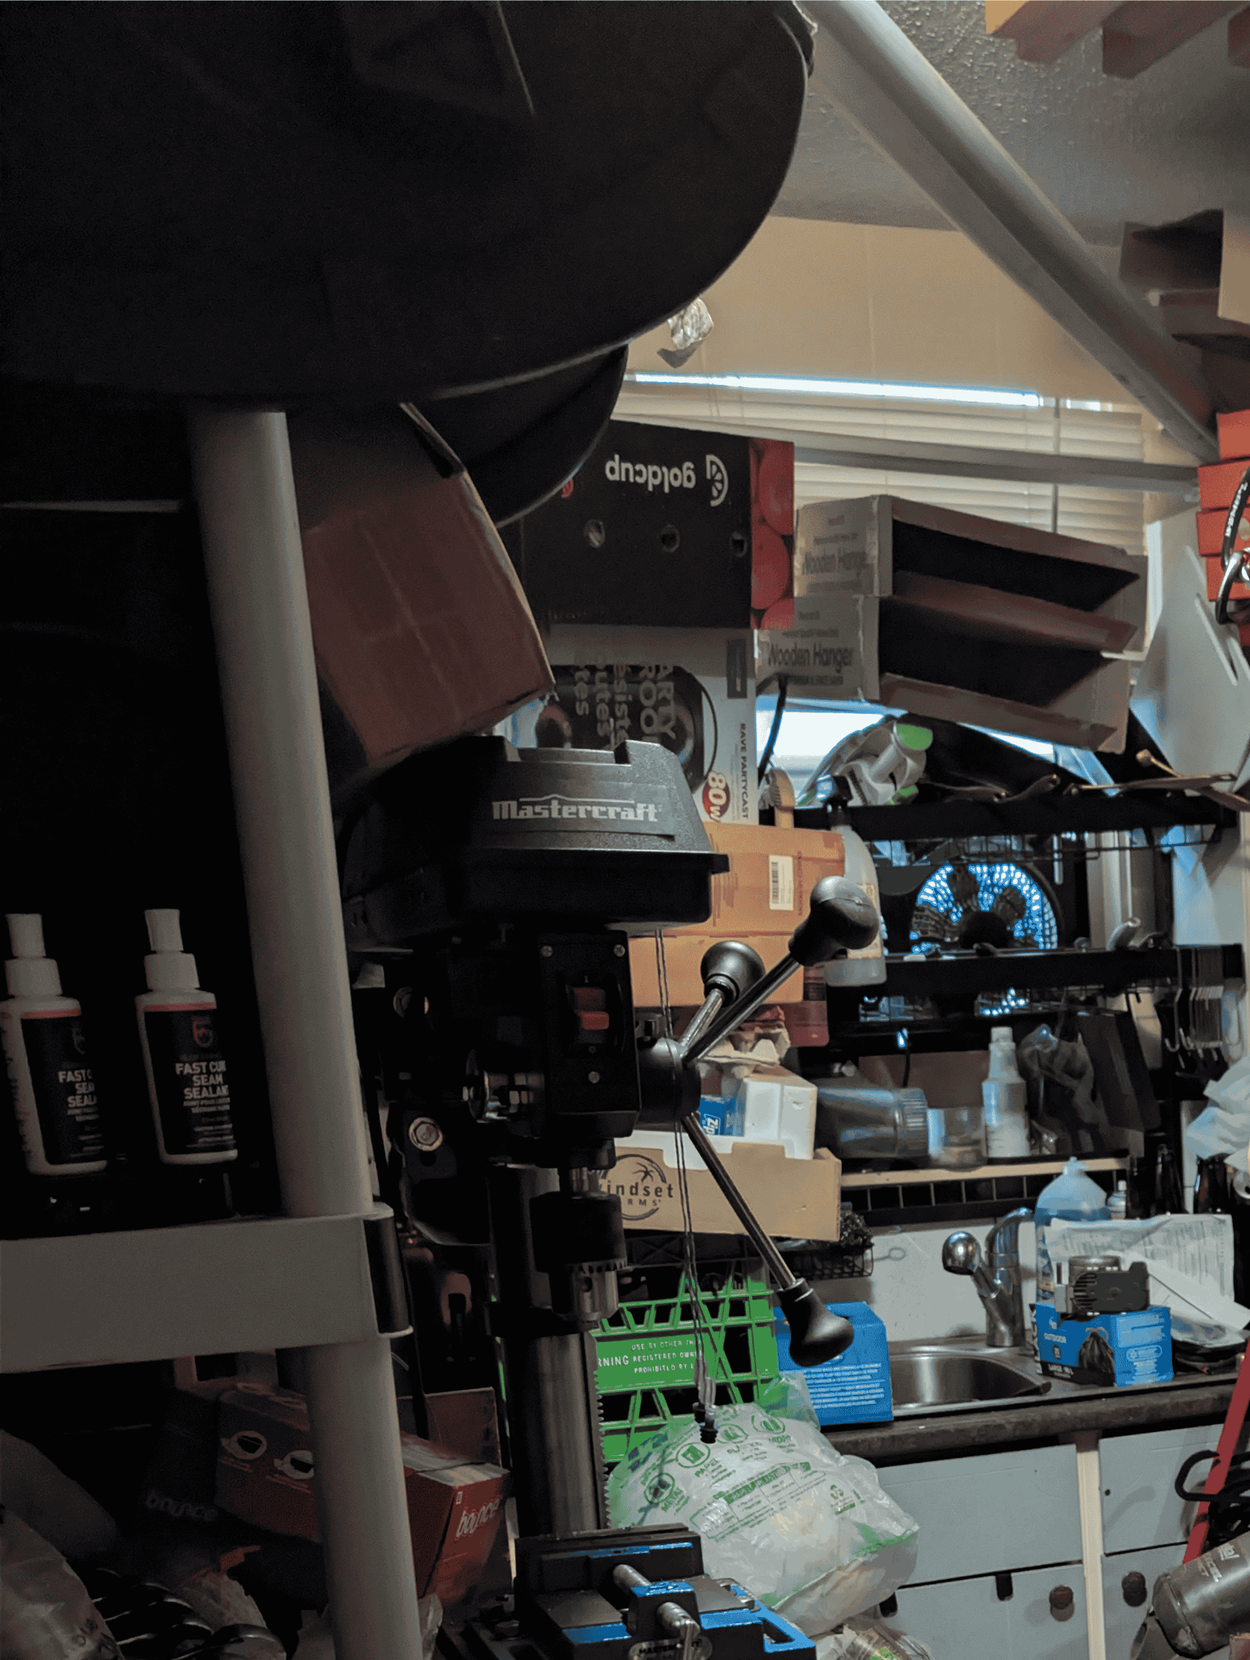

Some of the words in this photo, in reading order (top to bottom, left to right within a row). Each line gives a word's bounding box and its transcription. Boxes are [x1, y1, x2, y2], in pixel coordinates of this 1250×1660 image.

[605, 454, 696, 494] goldcup
[739, 722, 748, 752] RAVE
[739, 756, 750, 819] PARTYCAST
[492, 799, 658, 822] Mastercraft
[58, 1070, 86, 1083] FAST
[175, 1062, 207, 1075] FAST
[192, 1074, 223, 1087] SEAM
[633, 1353, 676, 1363] REGISTERED
[456, 1496, 501, 1538] bounce
